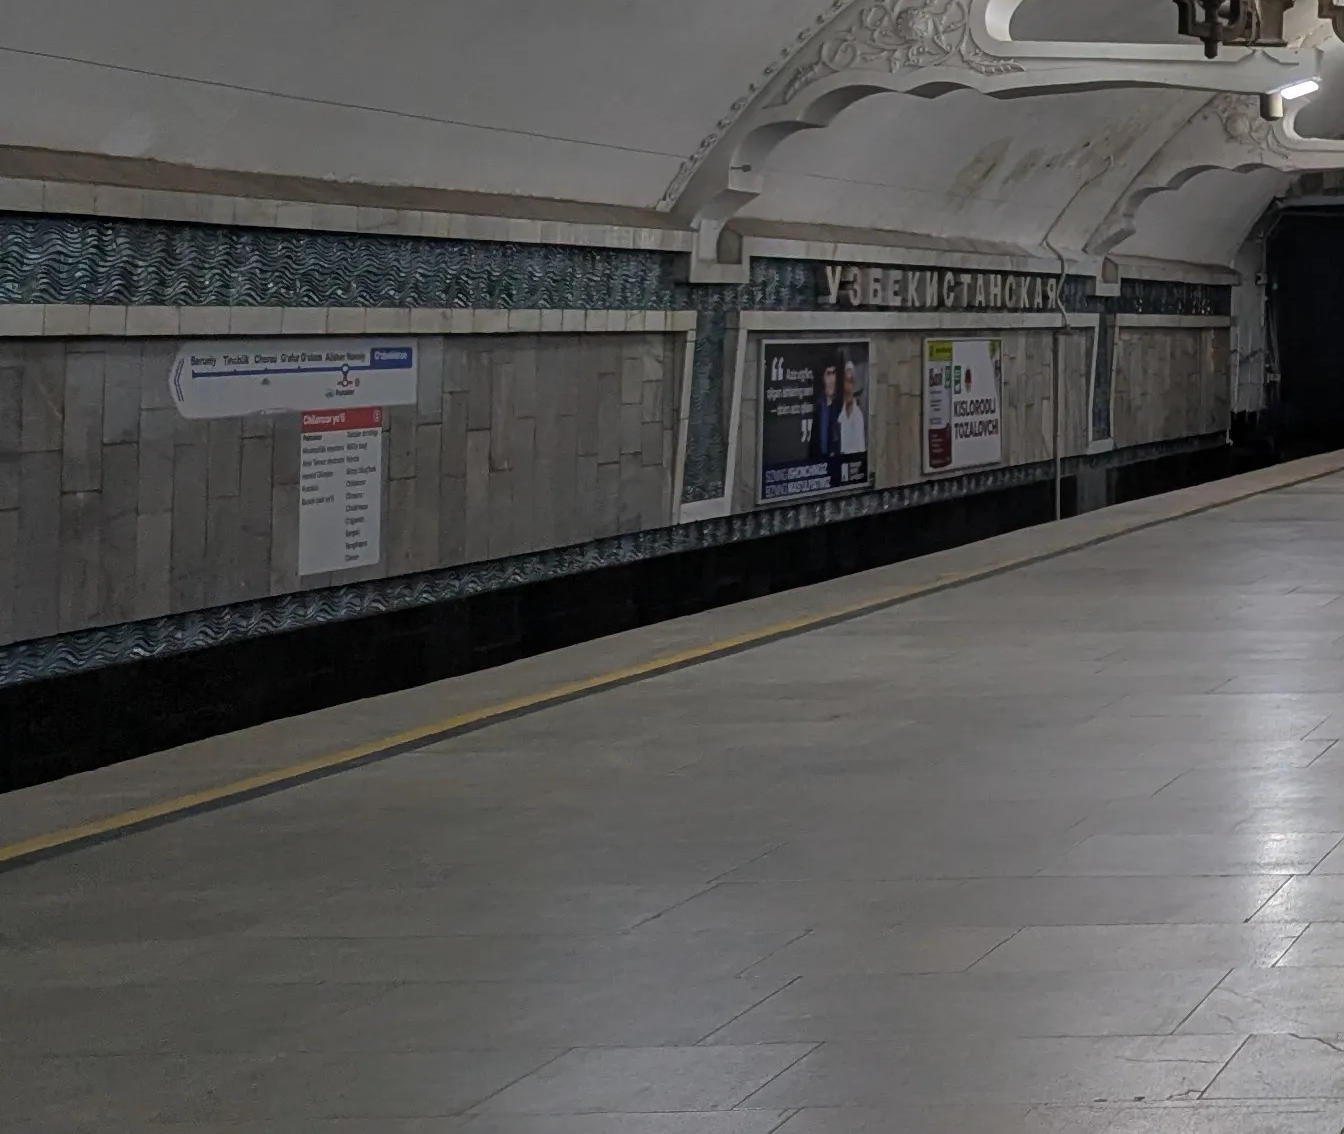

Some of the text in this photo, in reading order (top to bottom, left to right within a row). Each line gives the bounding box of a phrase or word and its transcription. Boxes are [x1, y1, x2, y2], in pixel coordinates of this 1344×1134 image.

[824, 264, 1057, 309] УЗБЕКИСТАНСКАЯ
[954, 397, 996, 417] KISLORODLI
[954, 418, 999, 440] TOZALOVCHI
